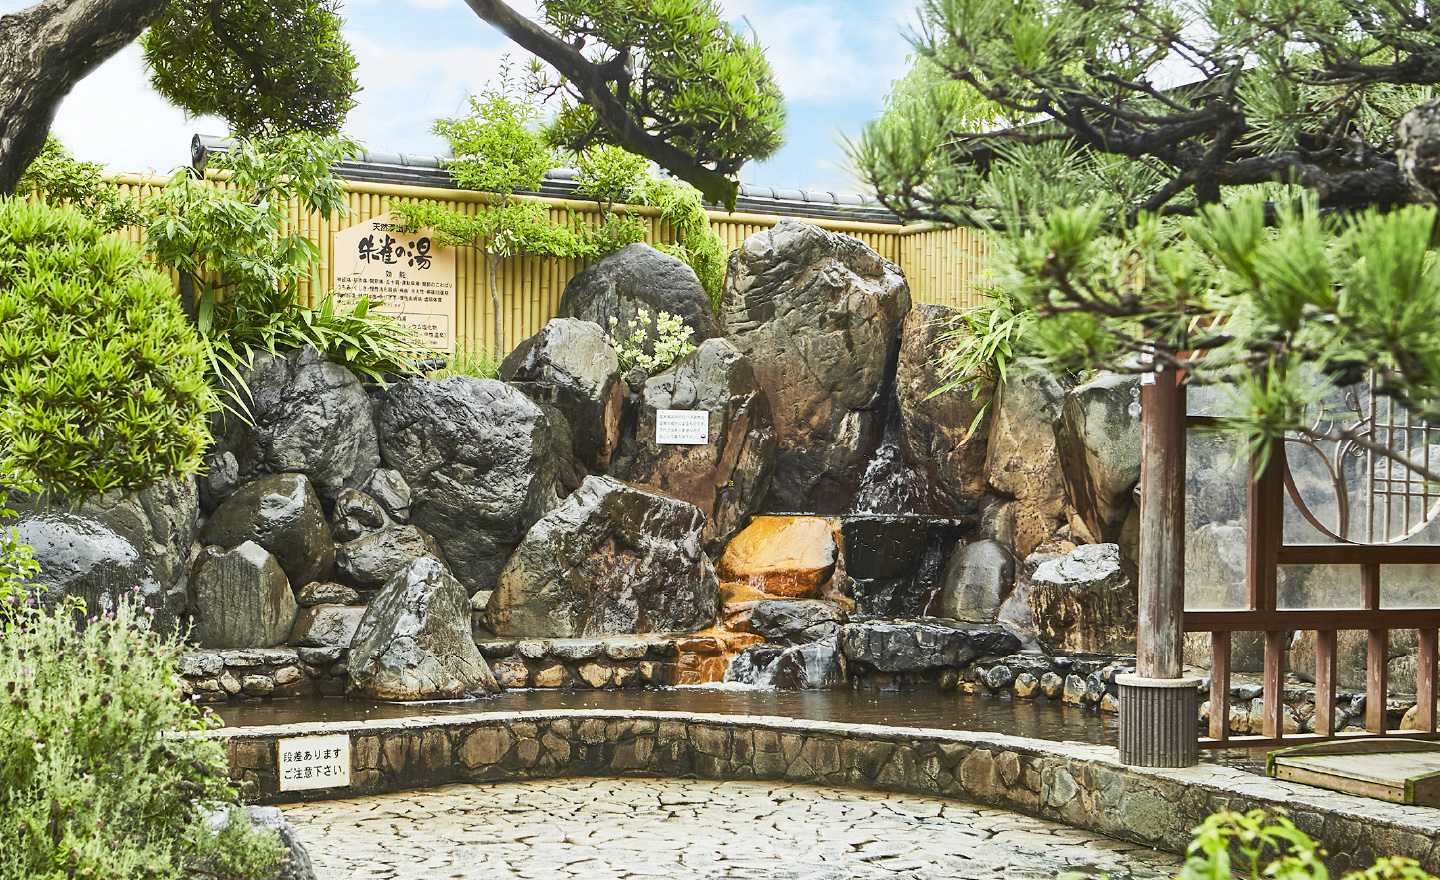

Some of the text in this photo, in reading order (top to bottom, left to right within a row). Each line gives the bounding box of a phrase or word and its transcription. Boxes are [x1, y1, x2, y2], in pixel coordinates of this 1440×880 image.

[358, 234, 432, 270] 朱雀の湯
[284, 748, 342, 762] 段差あります
[284, 765, 346, 780] ご注意下さい。
